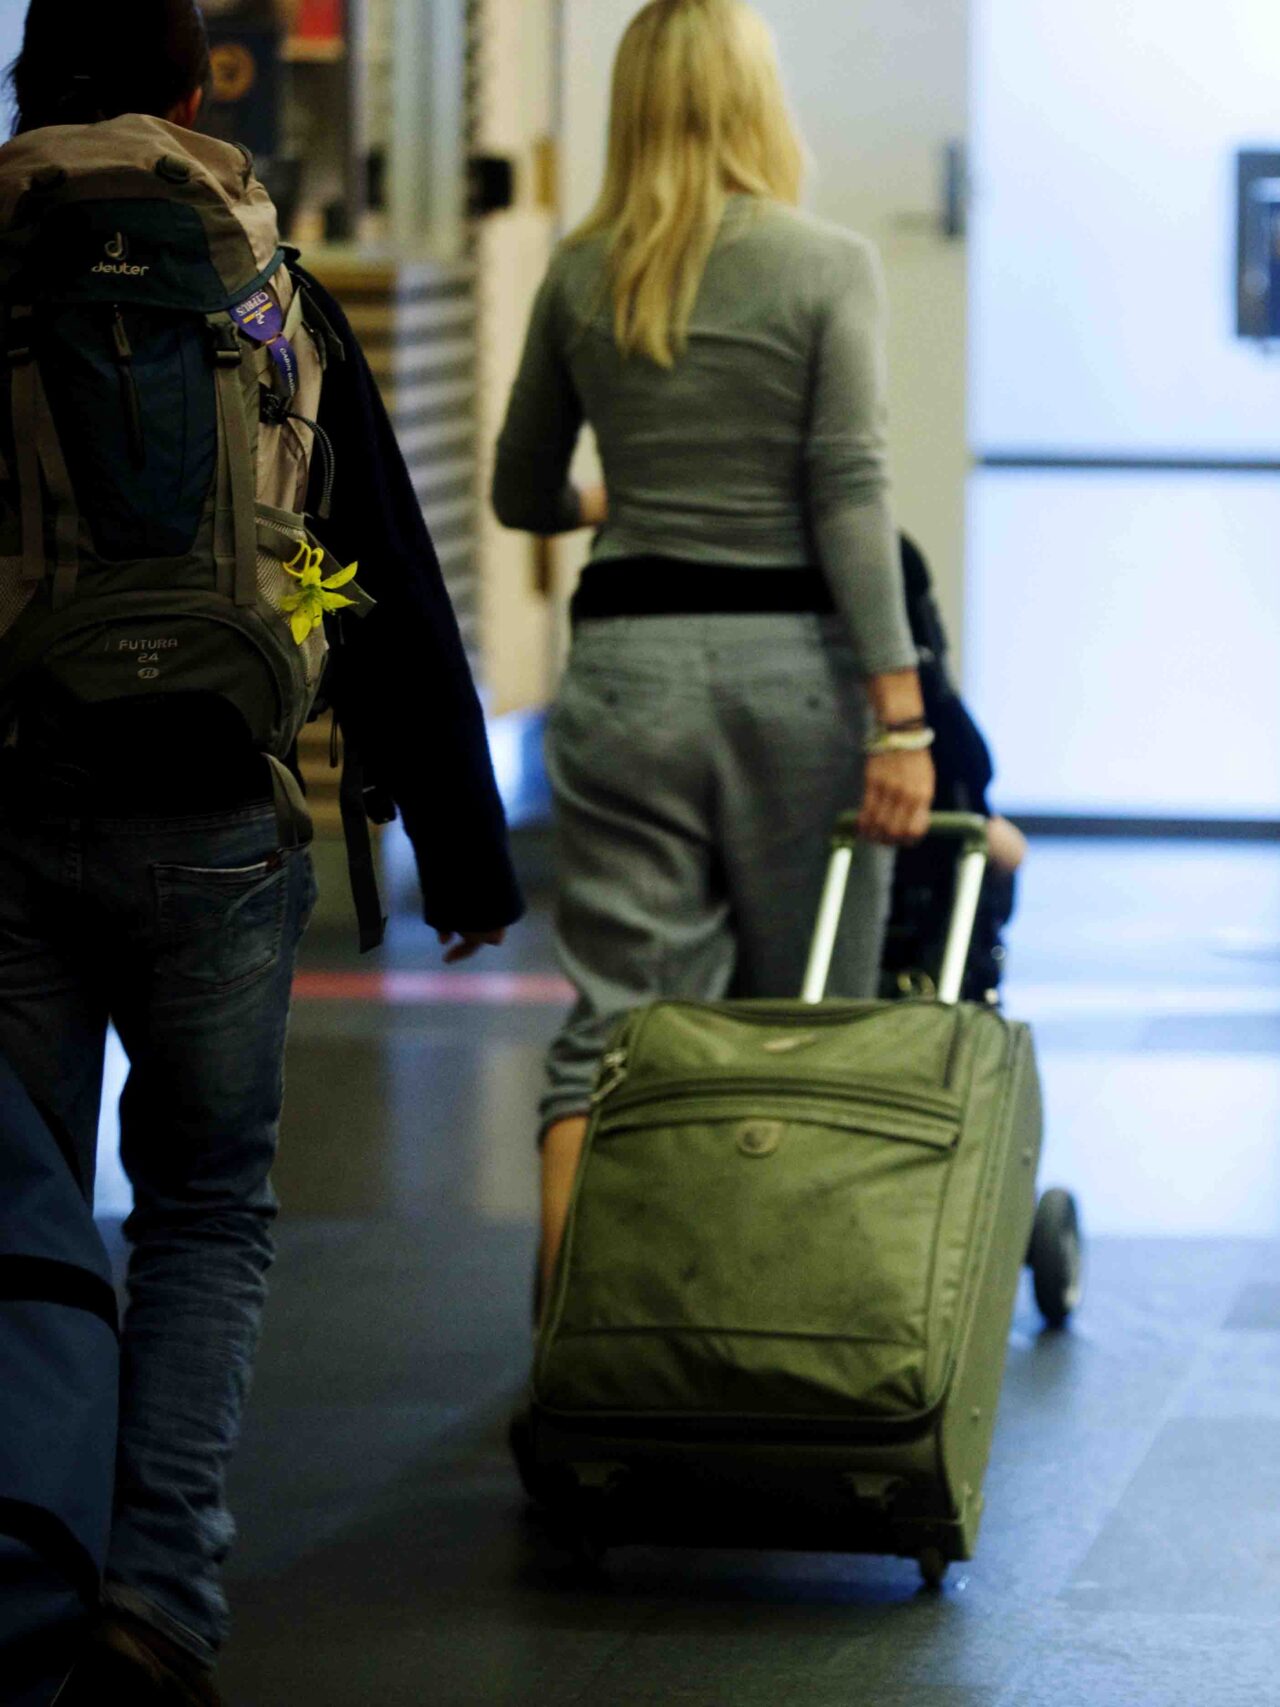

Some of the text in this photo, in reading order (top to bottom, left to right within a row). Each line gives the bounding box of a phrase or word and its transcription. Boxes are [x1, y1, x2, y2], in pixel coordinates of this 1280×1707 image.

[91, 261, 150, 276] deuter
[118, 639, 179, 651] FUTURA
[137, 652, 160, 663] 24
